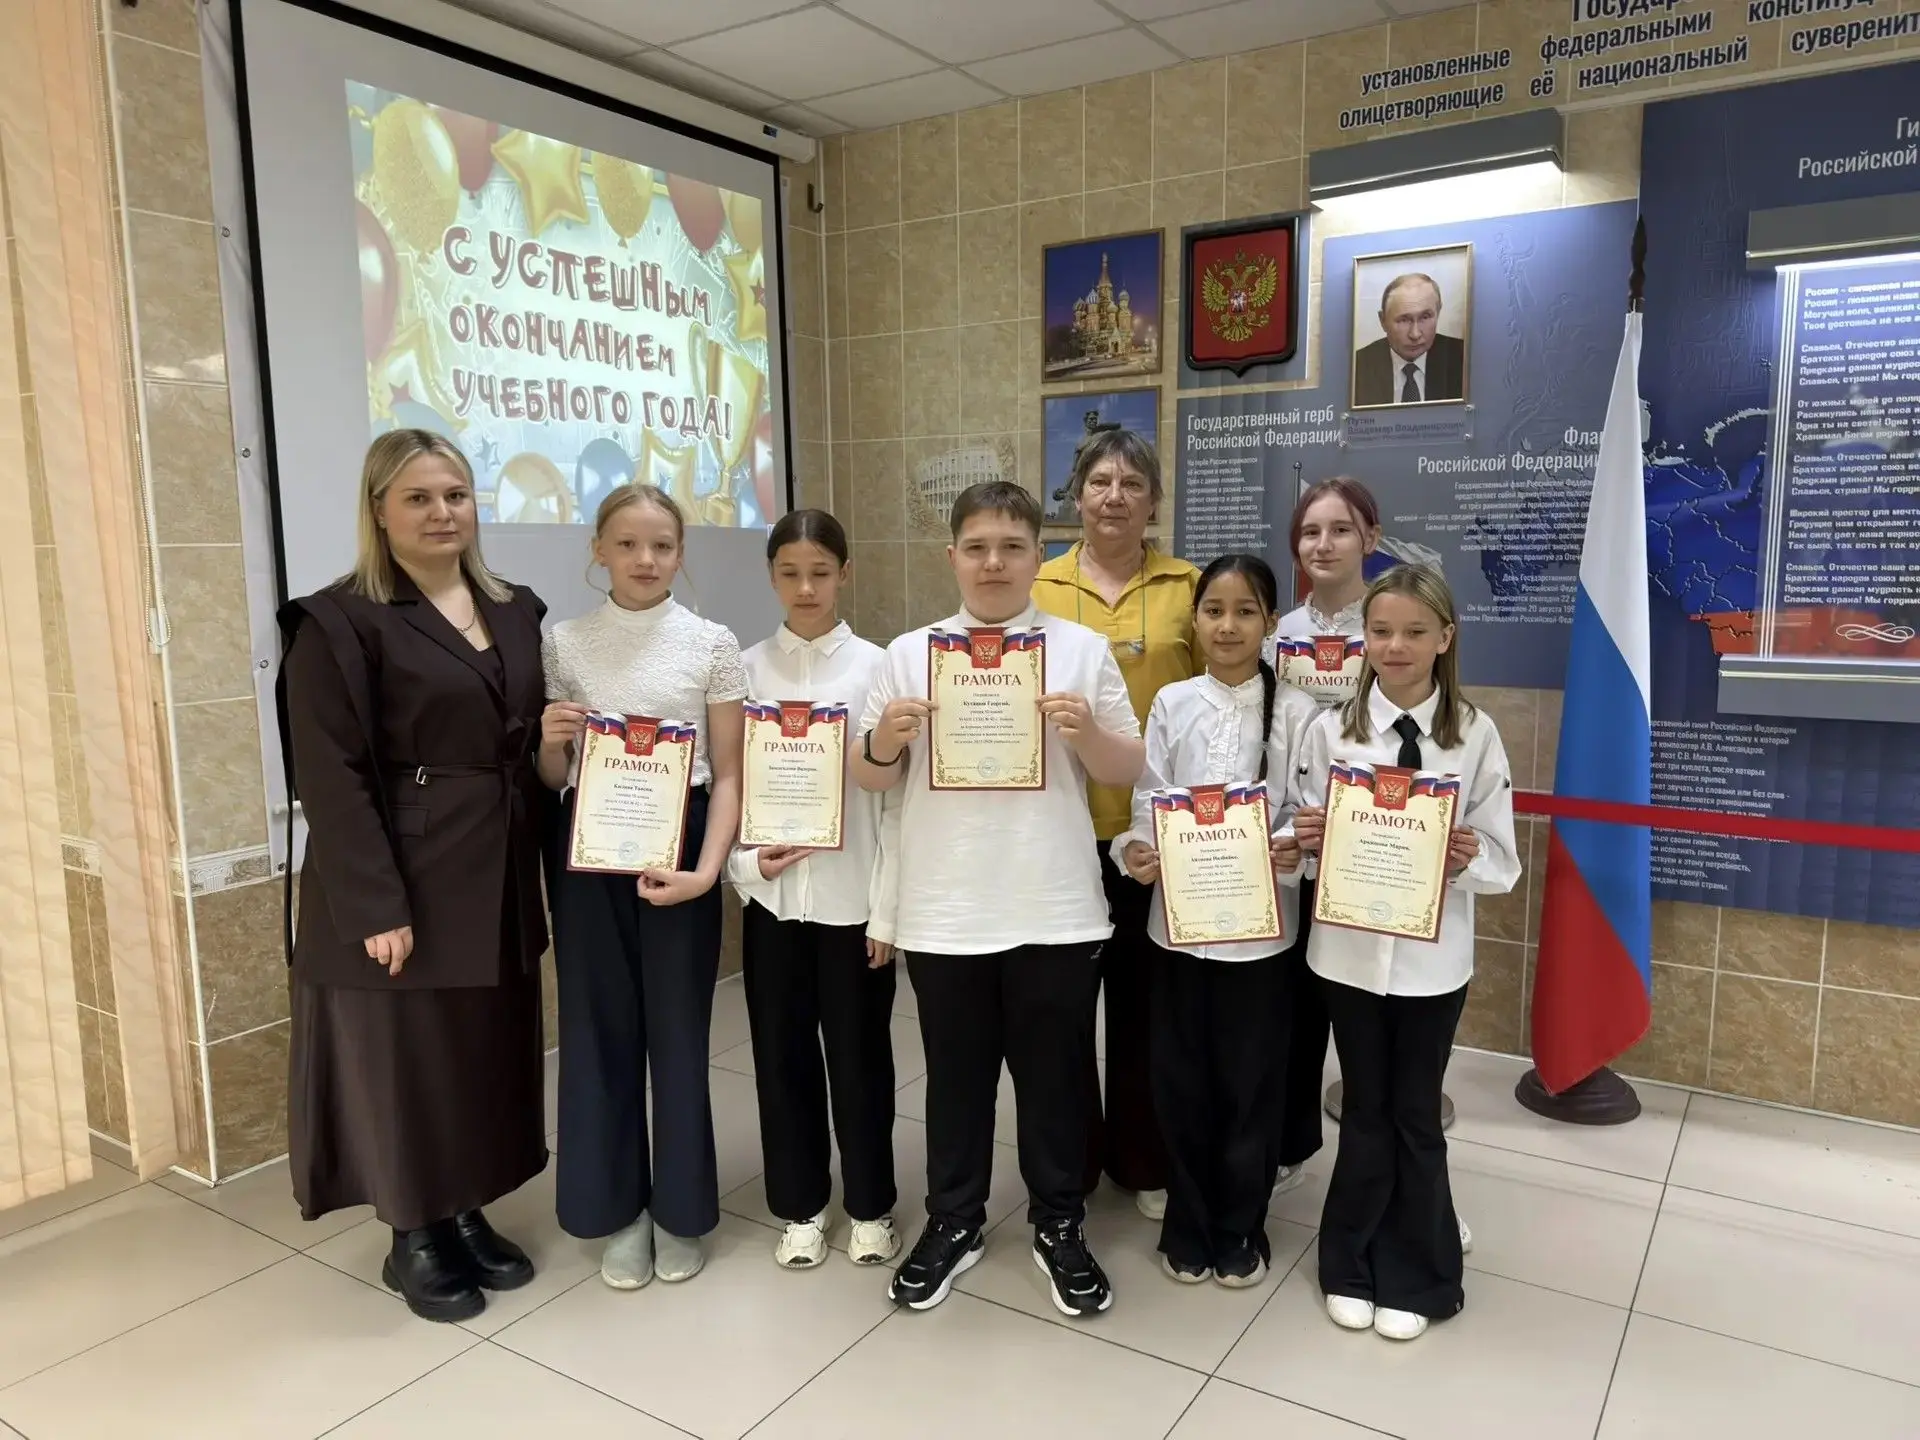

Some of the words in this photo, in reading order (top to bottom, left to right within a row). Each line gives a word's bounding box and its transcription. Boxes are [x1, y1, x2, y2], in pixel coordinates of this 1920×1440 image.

[1361, 48, 1511, 95] установленные
[1541, 9, 1712, 63] федеральными
[1749, 0, 1873, 22] консти
[1339, 84, 1504, 129] олицетворяющие
[1530, 71, 1554, 97] её
[1578, 37, 1748, 88] национальный
[1791, 12, 1920, 53] суверенит
[1798, 143, 1917, 179] Российской
[443, 226, 477, 276] С
[1805, 288, 1838, 297] Россия
[1804, 299, 1837, 308] Россия
[450, 303, 676, 378] ОКОНЧАНИЕМ
[1845, 340, 1896, 349] Отечество
[1800, 355, 1845, 364] Братских
[1848, 352, 1887, 361] народов
[1800, 366, 1845, 375] Предками
[1849, 364, 1882, 373] данная
[453, 368, 632, 425] УЧЕБНОГО
[642, 391, 733, 441] ГОДА!
[1798, 400, 1809, 408] От
[1187, 407, 1300, 432] Государственный
[1304, 404, 1334, 425] герб
[1797, 411, 1857, 419] Раскинулись
[1796, 422, 1818, 431] Одна
[1885, 418, 1908, 427] Одна
[1187, 432, 1261, 450] Российской
[1264, 428, 1342, 448] Федерации
[1837, 453, 1886, 461] Отечество
[1418, 454, 1506, 475] Российской
[1793, 466, 1836, 475] Братских
[1840, 464, 1878, 473] народов
[1792, 477, 1837, 485] Предками
[1873, 485, 1889, 493] Мы
[1829, 563, 1878, 571] Отечество
[1785, 574, 1828, 582] Братских
[1832, 575, 1870, 583] народов
[1784, 585, 1829, 593] Предками
[1832, 586, 1864, 594] данная
[1867, 586, 1913, 594] мудрость
[953, 674, 1022, 686] ГРАМОТА
[1298, 675, 1361, 686] ГРАМОТА
[764, 741, 825, 754] ГРАМОТА
[604, 757, 670, 775] ГРАМОТА
[1351, 810, 1426, 832] ГРАМОТА
[1179, 828, 1248, 844] ГРАМОТА
